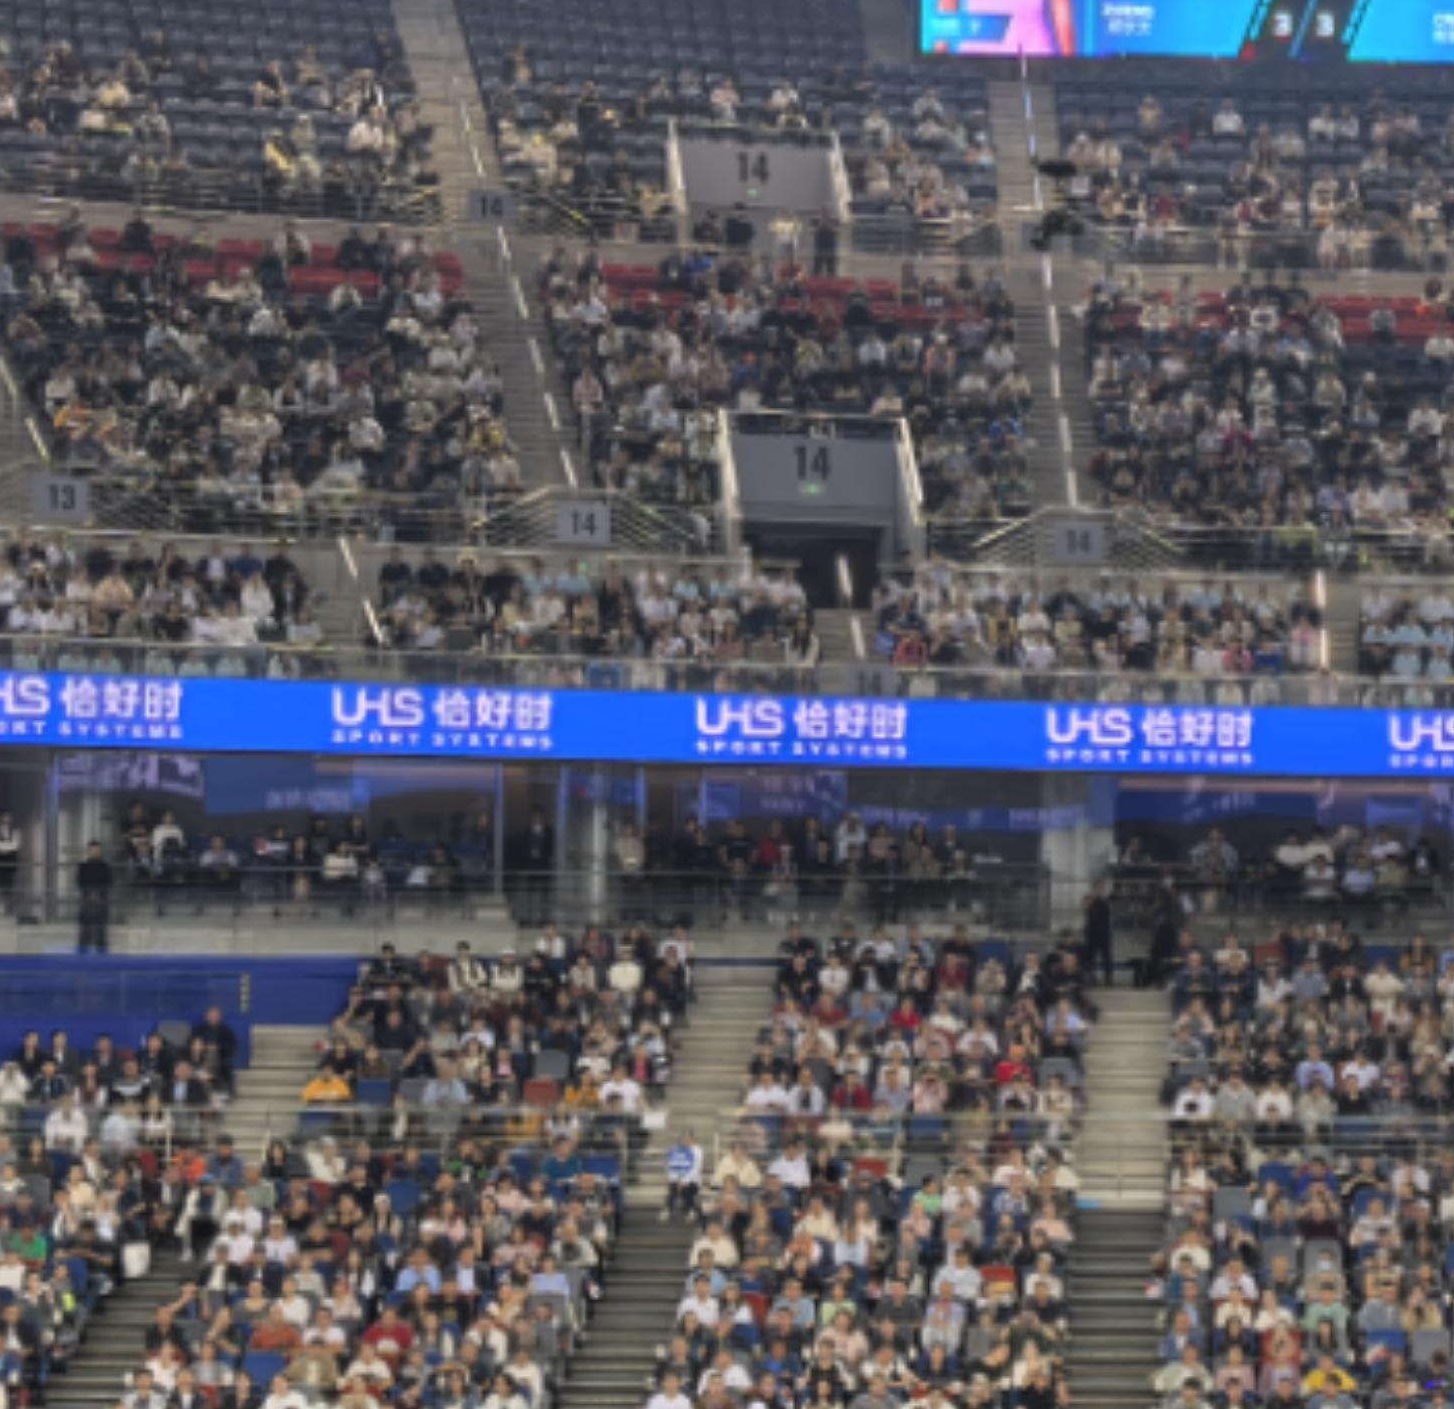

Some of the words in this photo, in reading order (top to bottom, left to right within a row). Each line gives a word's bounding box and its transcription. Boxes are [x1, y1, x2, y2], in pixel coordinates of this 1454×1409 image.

[736, 151, 769, 184] 14
[479, 196, 504, 218] 14
[793, 445, 832, 481] 14
[48, 483, 77, 511] 13
[571, 511, 597, 535] 14
[61, 677, 184, 720] 恰好时
[433, 689, 553, 731] 恰好时
[794, 698, 908, 740] 恰好时
[1142, 709, 1253, 748] 恰好时
